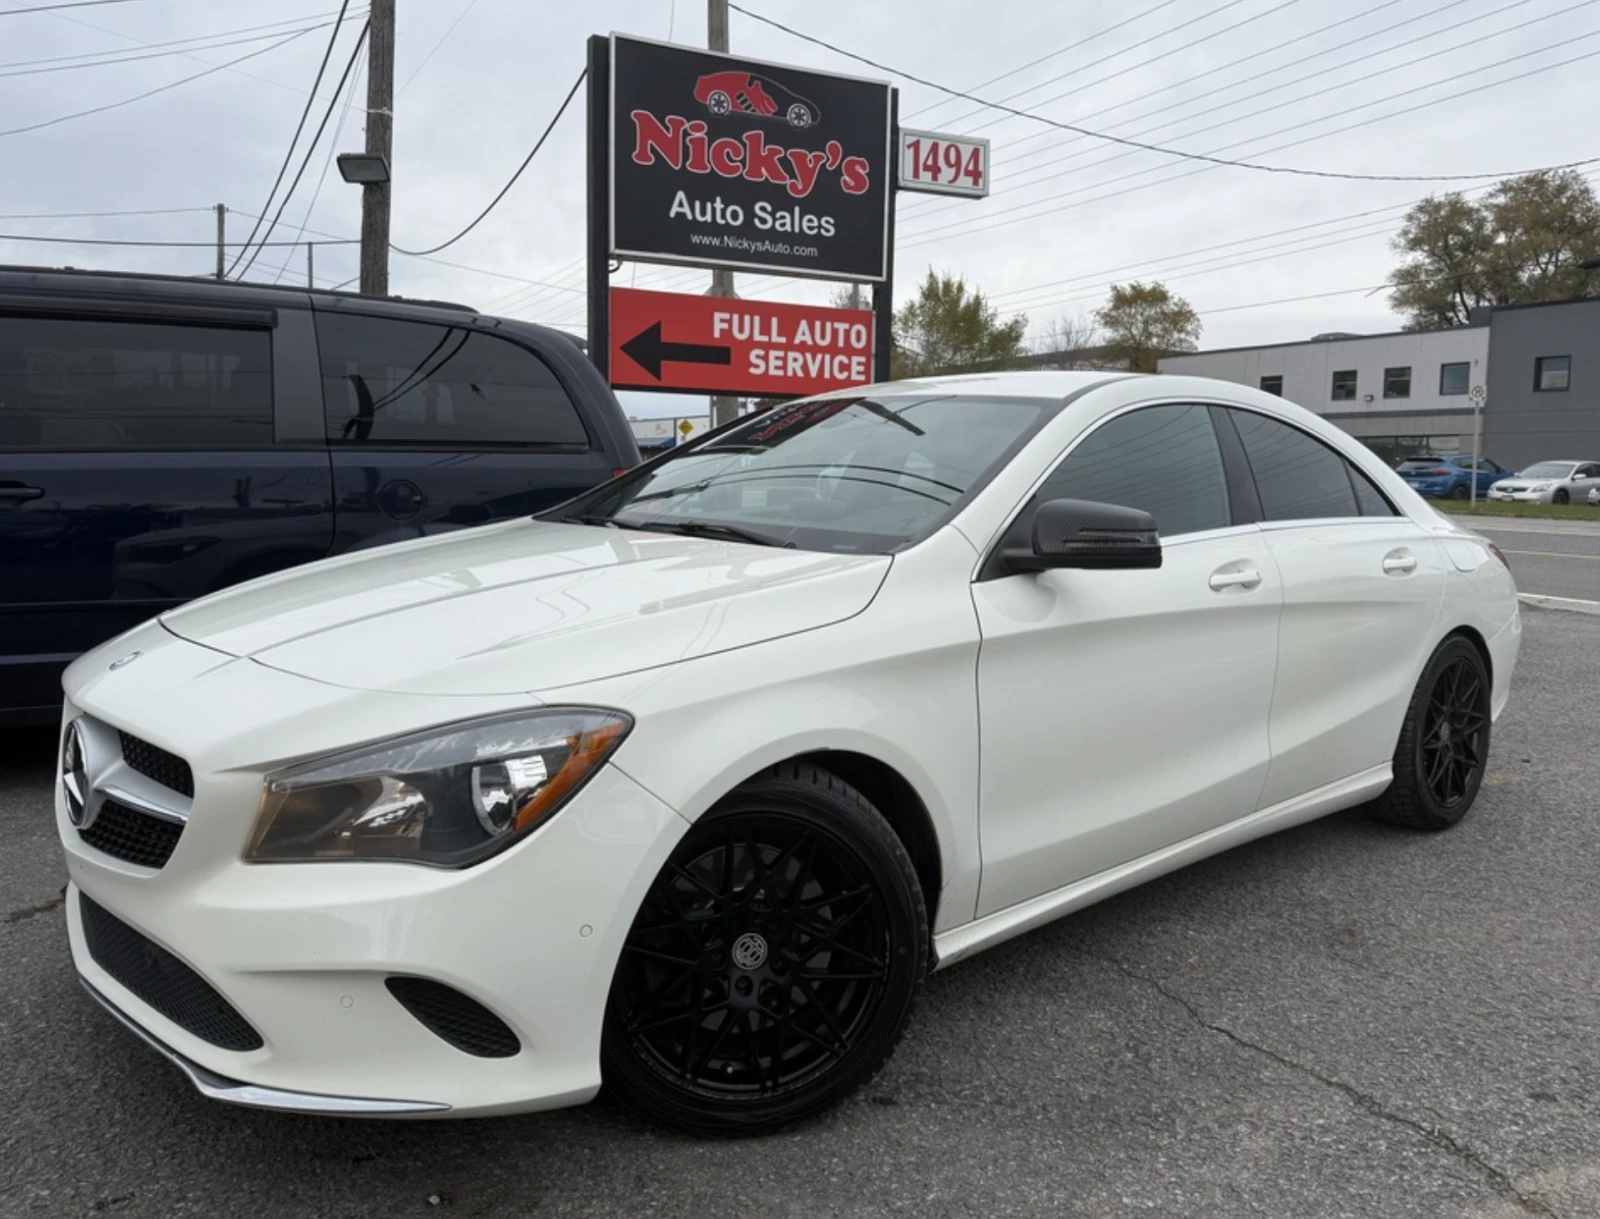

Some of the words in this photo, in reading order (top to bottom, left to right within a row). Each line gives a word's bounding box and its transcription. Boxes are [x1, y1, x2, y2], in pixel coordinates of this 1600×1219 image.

[631, 109, 870, 198] Nicky's
[906, 138, 983, 188] 1494
[669, 189, 744, 227] Auto
[754, 201, 836, 237] Sales
[690, 232, 818, 257] www.NickysAuto.com
[713, 311, 787, 344] FULL
[794, 319, 867, 349] AUTO
[748, 348, 867, 381] SERVICE
